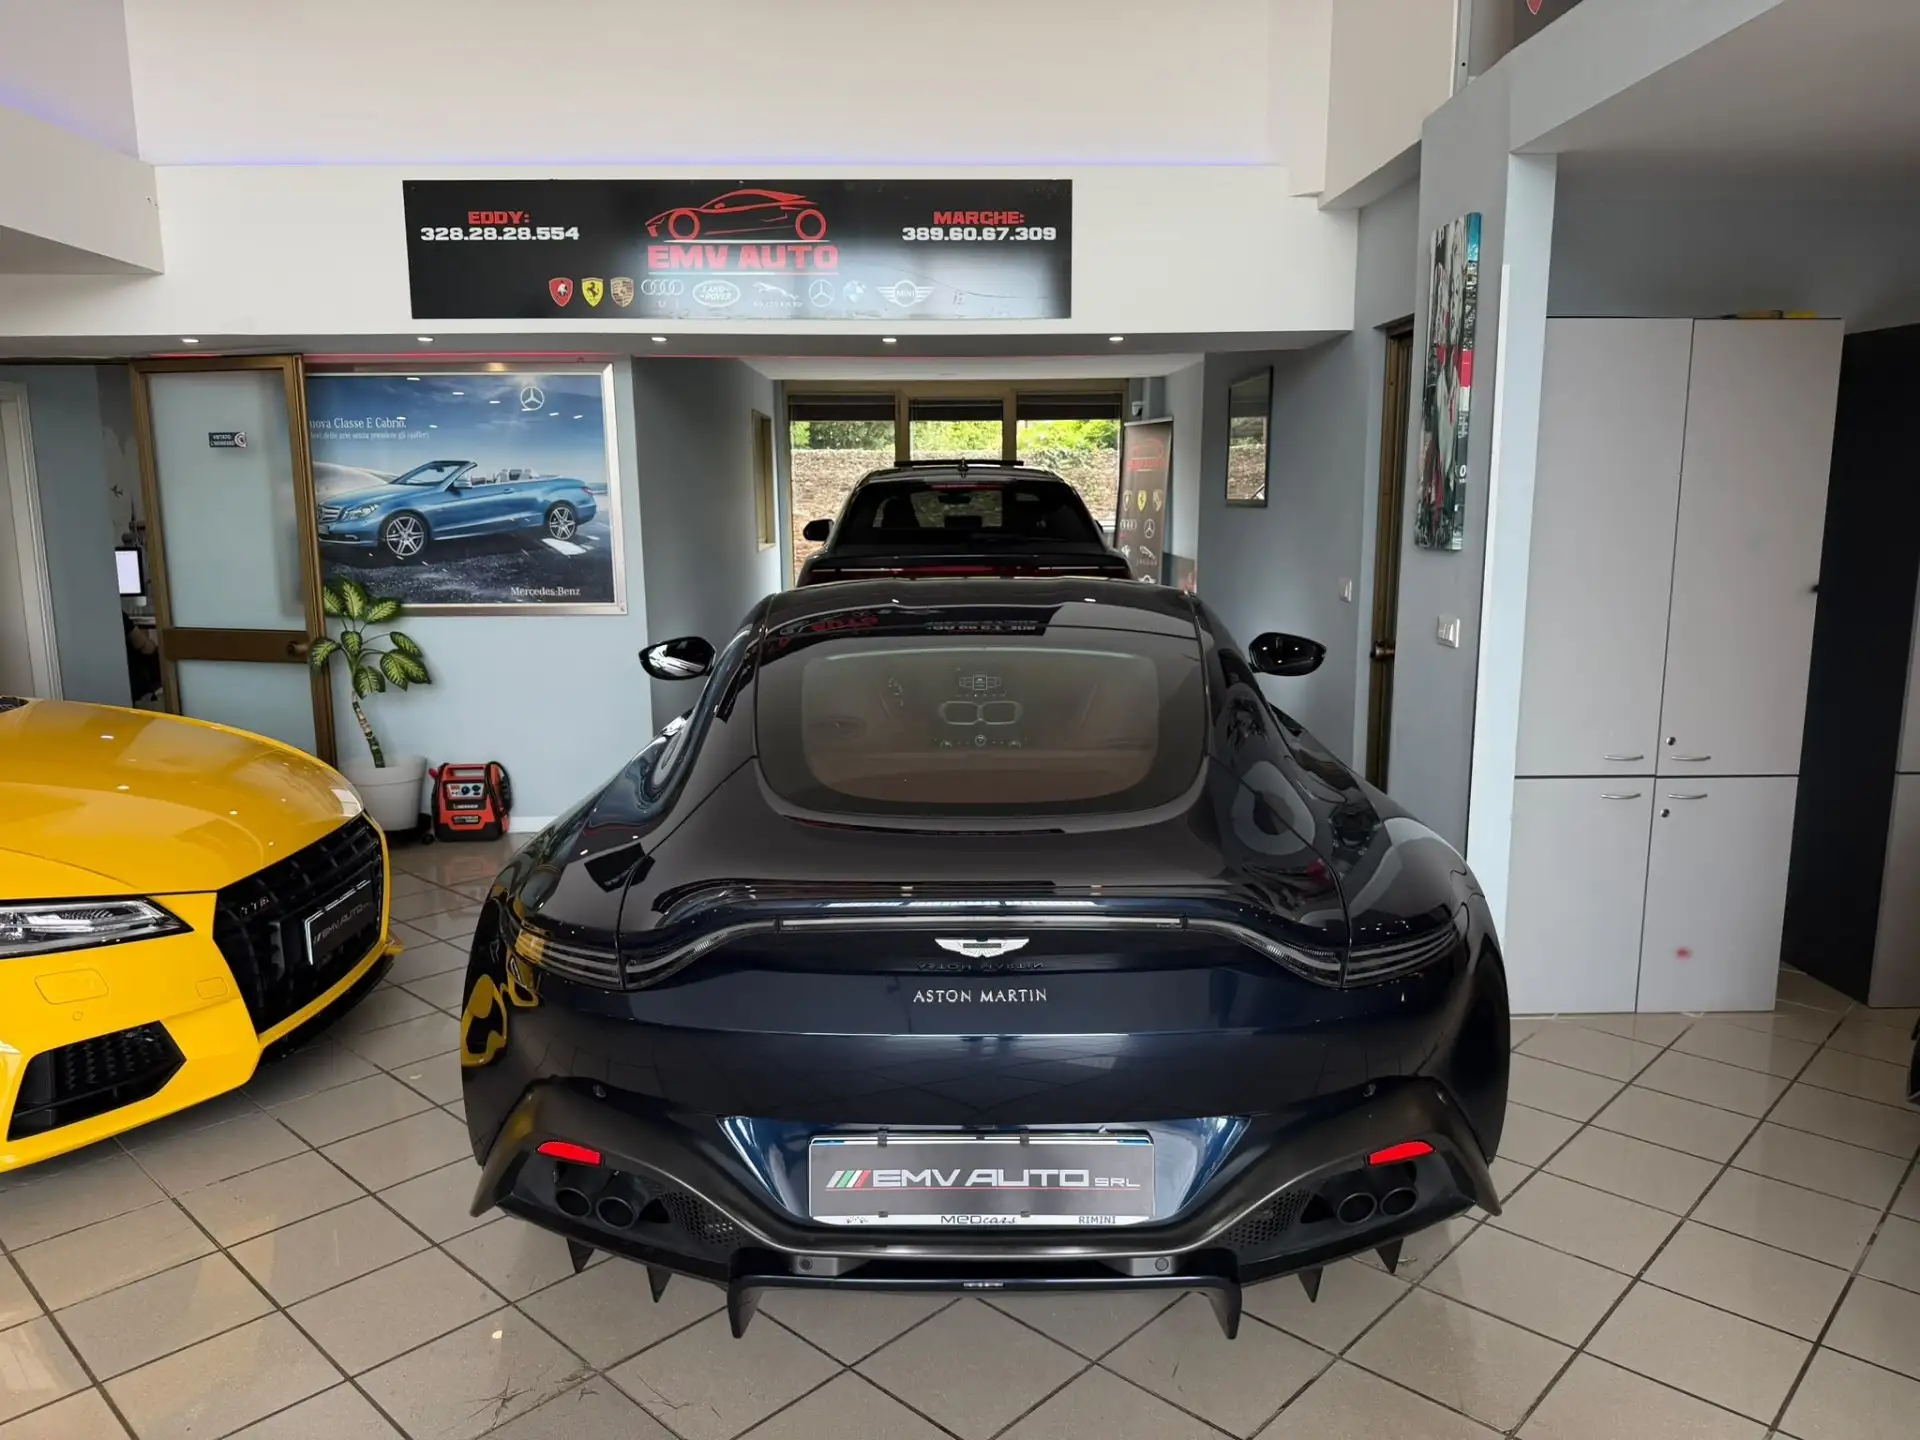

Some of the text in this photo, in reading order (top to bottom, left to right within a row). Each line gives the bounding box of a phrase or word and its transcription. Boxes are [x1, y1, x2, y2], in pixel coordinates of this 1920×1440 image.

[468, 211, 530, 224] EDDY:
[933, 211, 1025, 225] MARCHE:
[420, 227, 579, 240] 328.28.28.554
[902, 227, 1057, 240] 389.60.67.309
[647, 245, 839, 270] EMV AUTO
[334, 417, 364, 429] Classe
[366, 417, 373, 429] E
[510, 586, 580, 597] Mercedes-Benz
[913, 988, 1047, 1003] ASTON MARTIN
[873, 1168, 1141, 1188] EMV AUTO SRL
[1078, 1215, 1117, 1225] RIMINI
